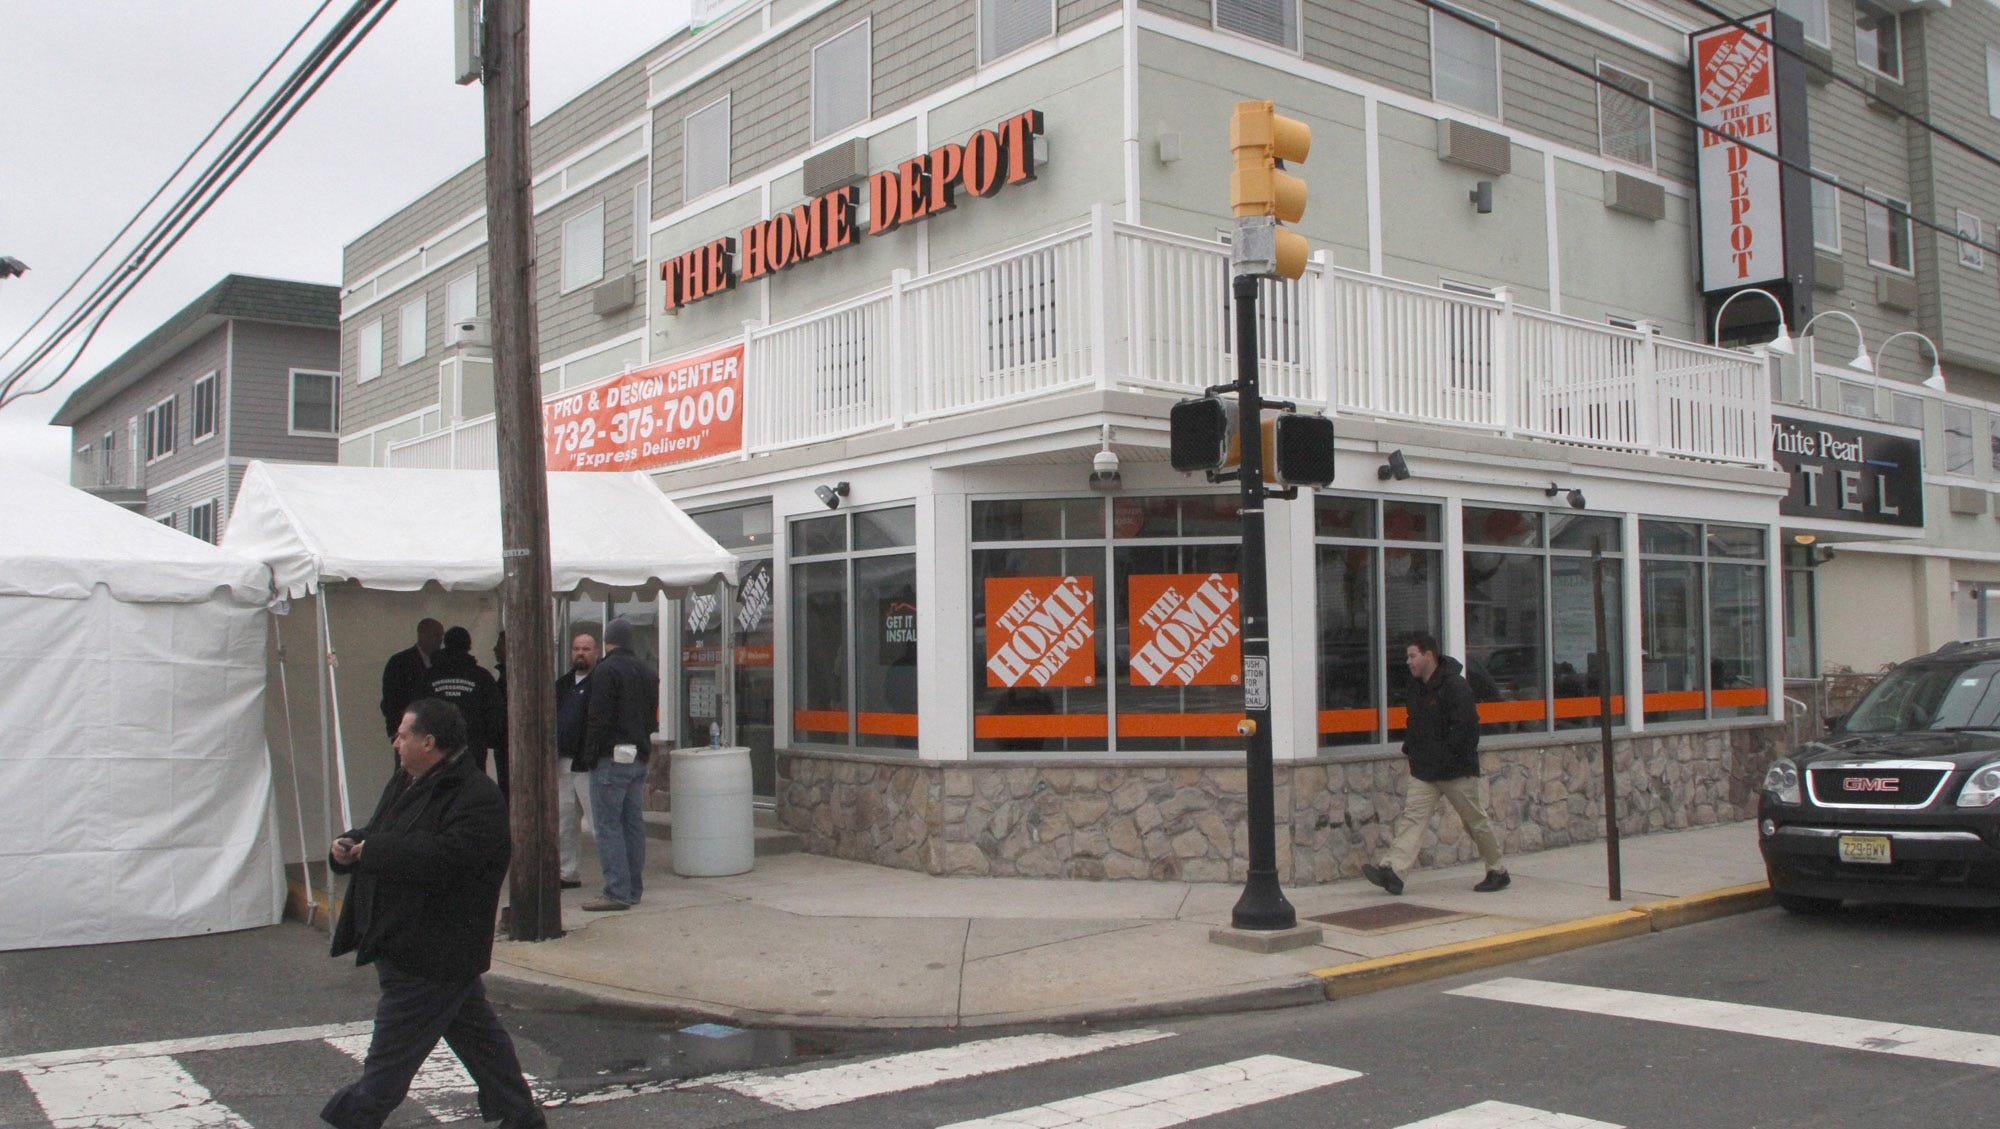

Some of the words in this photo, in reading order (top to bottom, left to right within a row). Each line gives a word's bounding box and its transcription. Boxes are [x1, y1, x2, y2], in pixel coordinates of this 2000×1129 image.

[1705, 40, 1733, 73] THE
[1727, 49, 1768, 104] DEPOT
[1702, 112, 1772, 148] HOME
[1722, 104, 1749, 121] THE
[660, 237, 735, 310] THE
[740, 186, 859, 282] HOME
[867, 109, 1043, 236] DEPOT
[1727, 144, 1753, 279] DEPOT
[553, 392, 583, 420] PRO
[588, 389, 599, 411] &
[606, 375, 664, 408] DESIGN
[668, 356, 738, 394] CENTER
[553, 386, 735, 455] 732-375-7000
[570, 446, 638, 468] "Express
[642, 429, 710, 457] Delivery"
[1819, 430, 1864, 463] Pearl
[886, 615, 902, 629] GET
[905, 615, 913, 628] IT
[995, 588, 1041, 633] THE
[1130, 573, 1238, 685] HOME
[1138, 586, 1184, 631] THE
[987, 576, 1094, 687] HOME
[1029, 615, 1094, 687] DEPOT
[1172, 614, 1240, 685] DEPOT
[1245, 669, 1264, 677] TTON
[1246, 696, 1263, 705] GNAL
[1843, 778, 1899, 791] GMC
